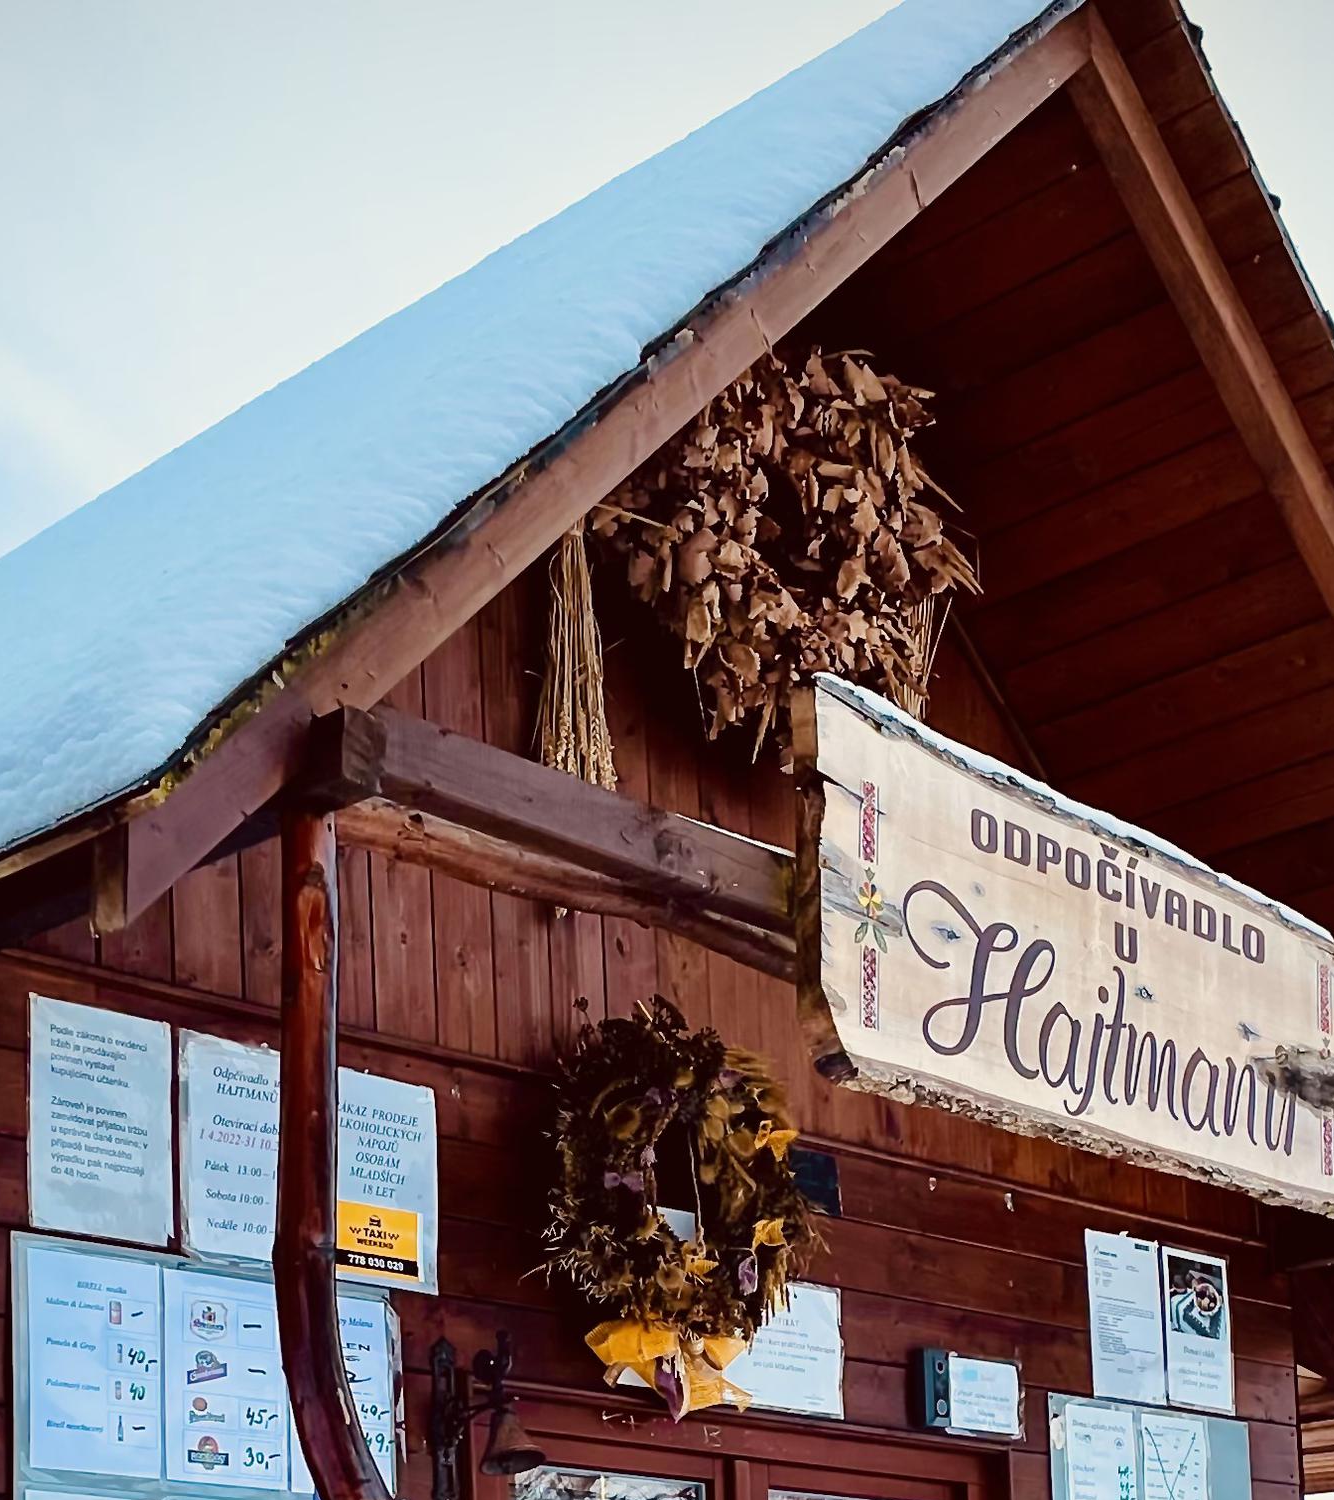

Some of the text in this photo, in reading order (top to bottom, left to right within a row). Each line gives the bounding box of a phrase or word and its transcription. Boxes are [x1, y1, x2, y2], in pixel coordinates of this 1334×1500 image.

[970, 808, 1266, 965] ODPOČÍVADLO
[1114, 921, 1139, 965] U
[339, 1100, 419, 1127] ÁKAZ PRODEJE
[259, 1122, 279, 1136] dob
[339, 1117, 422, 1143] LKOHOLICKÝCH
[357, 1136, 399, 1154] NÁPOJŮ
[204, 1160, 229, 1173] Pátek
[355, 1151, 401, 1169] OSOBÁM
[349, 1166, 405, 1186] MLADŠÍCH
[205, 1188, 237, 1202] Sobota
[363, 1184, 396, 1198] 18 LET
[207, 1217, 239, 1231] Neděle
[363, 1227, 387, 1240] TAXI
[356, 1238, 394, 1250] WEEKEND
[347, 1254, 366, 1266] 778
